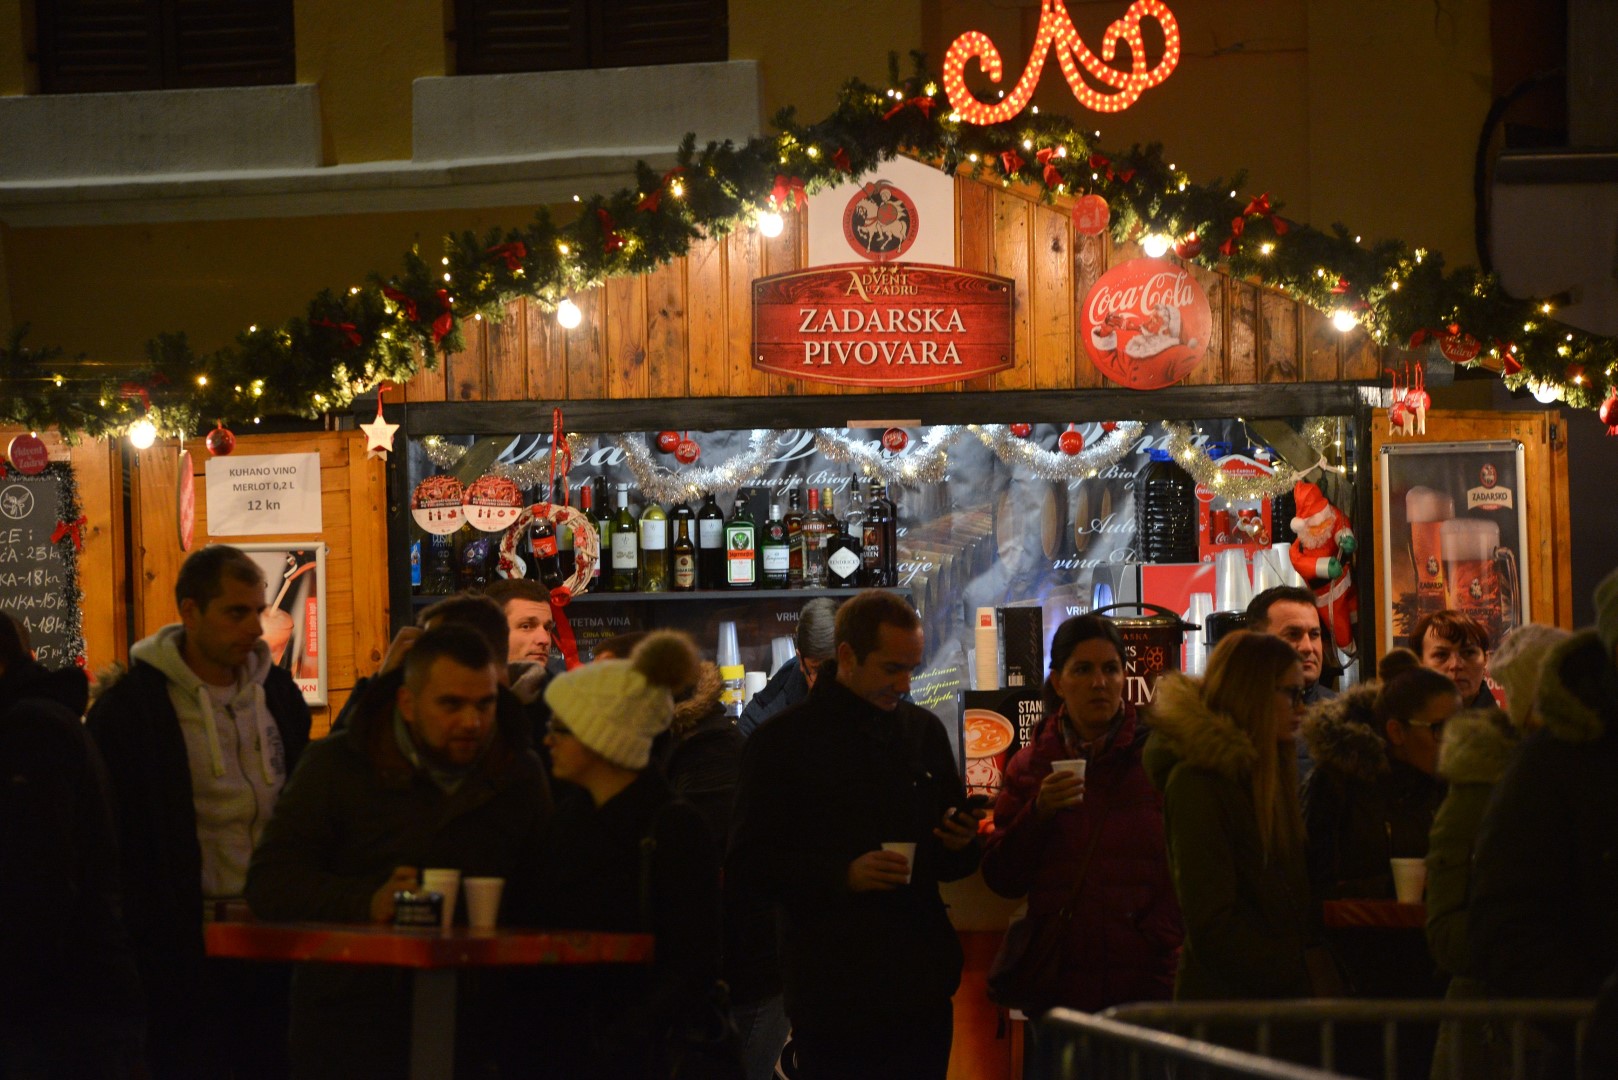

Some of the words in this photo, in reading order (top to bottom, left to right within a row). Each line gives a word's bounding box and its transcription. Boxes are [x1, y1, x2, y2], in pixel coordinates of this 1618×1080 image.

[845, 270, 909, 302] ADVENT
[874, 285, 918, 295] ZADRU
[1088, 271, 1195, 326] Coca-Cola
[799, 308, 967, 335] ZADARSKA
[802, 341, 963, 366] PIVOVARA
[229, 467, 271, 477] KUHANO
[273, 466, 297, 475] VINO
[233, 482, 271, 491] MERLOT
[273, 481, 287, 491] 0,2
[289, 481, 295, 490] L
[1472, 492, 1508, 502] ZADARSKO
[247, 500, 262, 511] 12
[265, 499, 281, 510] kn
[606, 616, 631, 626] VINA
[1123, 633, 1149, 641] ASKA
[301, 684, 317, 692] KN
